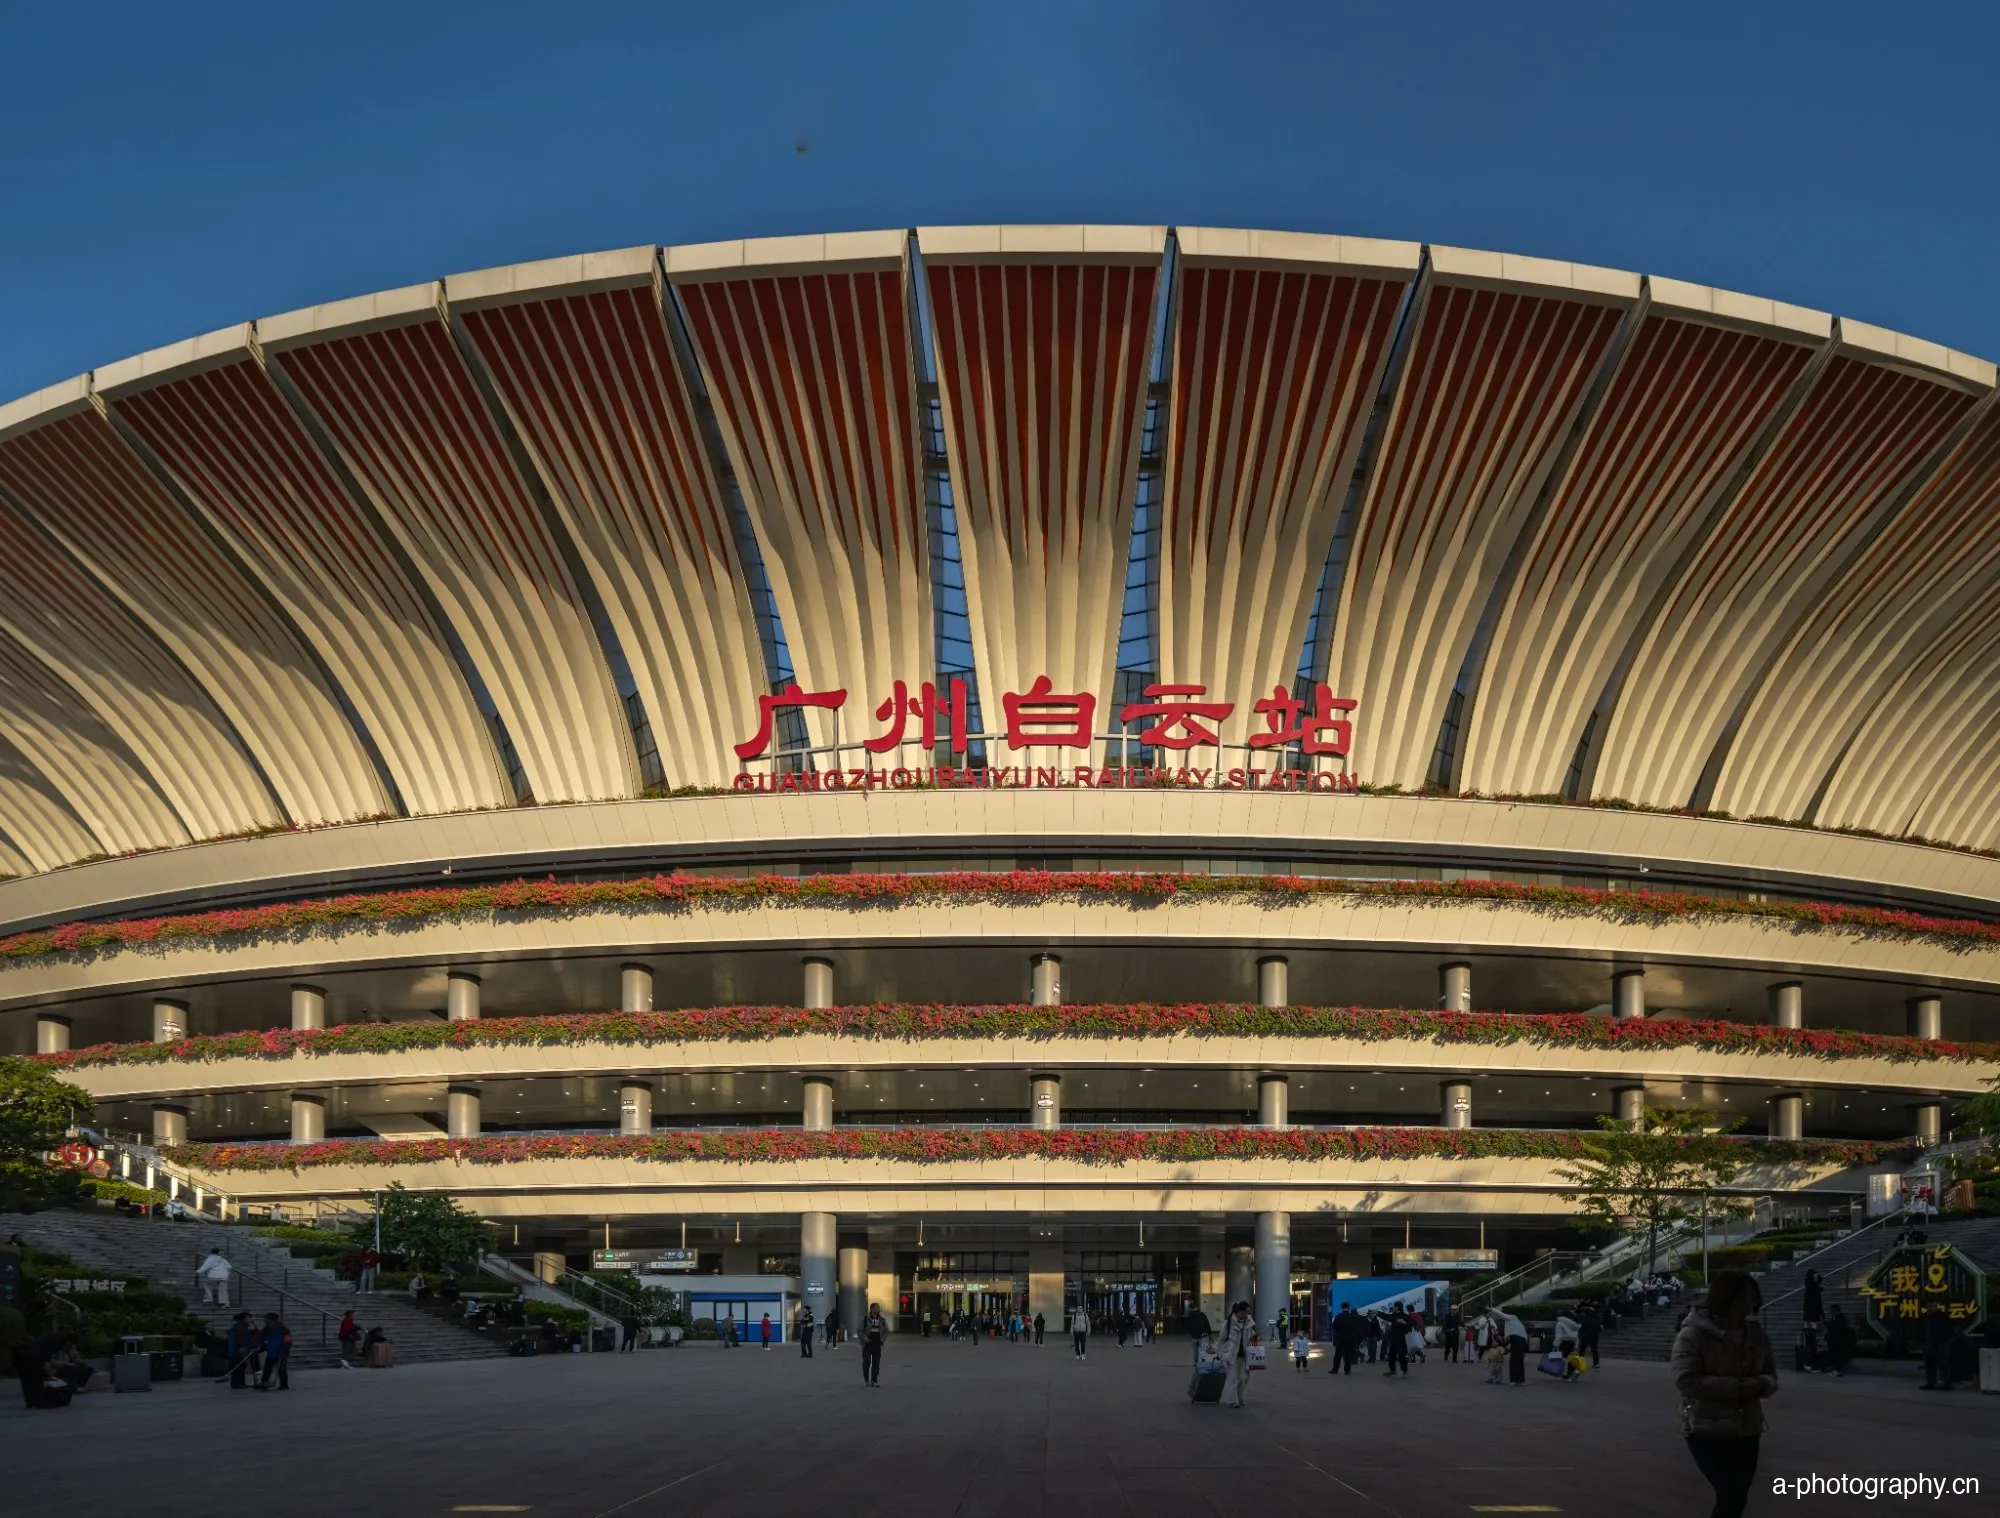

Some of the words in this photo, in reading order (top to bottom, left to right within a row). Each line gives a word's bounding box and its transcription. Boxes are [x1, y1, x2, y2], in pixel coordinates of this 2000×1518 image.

[734, 675, 1358, 760] 广州白云站
[1074, 766, 1212, 789] RAILWAY
[1227, 768, 1358, 792] STATION
[1891, 1265, 1919, 1293] 我
